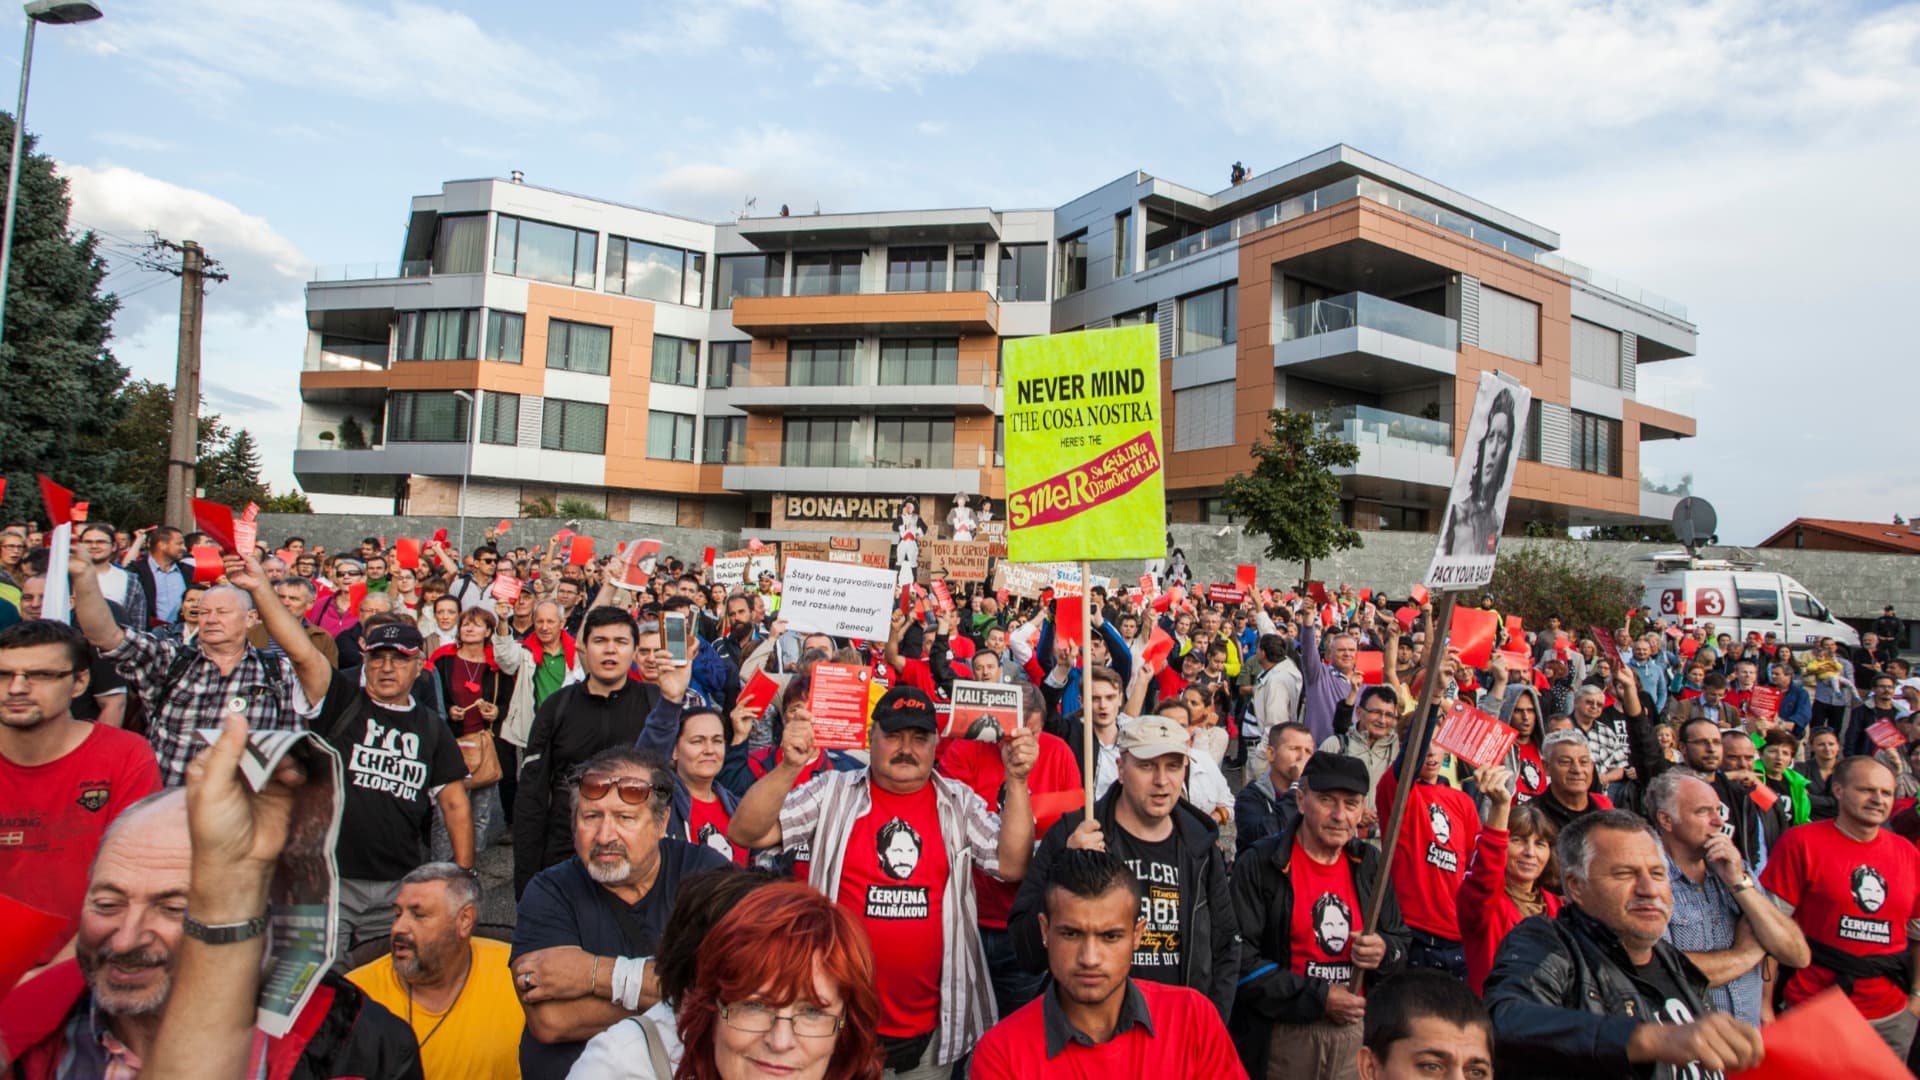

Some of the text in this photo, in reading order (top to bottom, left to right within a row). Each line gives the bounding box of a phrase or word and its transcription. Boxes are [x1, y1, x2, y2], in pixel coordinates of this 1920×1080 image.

[1018, 368, 1145, 405] NEVER MIND
[1010, 401, 1153, 432] THE COSA NOSTRA
[1060, 435, 1102, 448] HERE'S THE
[962, 545, 988, 558] CIRKUS
[816, 574, 831, 583] bez
[833, 577, 893, 590] spravodlivosti
[1431, 565, 1491, 582] PACK YOUR BAGS
[789, 585, 803, 593] nie
[1663, 591, 1675, 612] 3
[1704, 591, 1722, 615] 3
[836, 622, 873, 633] (Seneca)
[956, 689, 1017, 707] KALI špeciál
[868, 885, 927, 904] ČERVENÁ
[867, 903, 928, 917] KALIŇÁKOVI
[1841, 915, 1889, 934] ČERVENÁ
